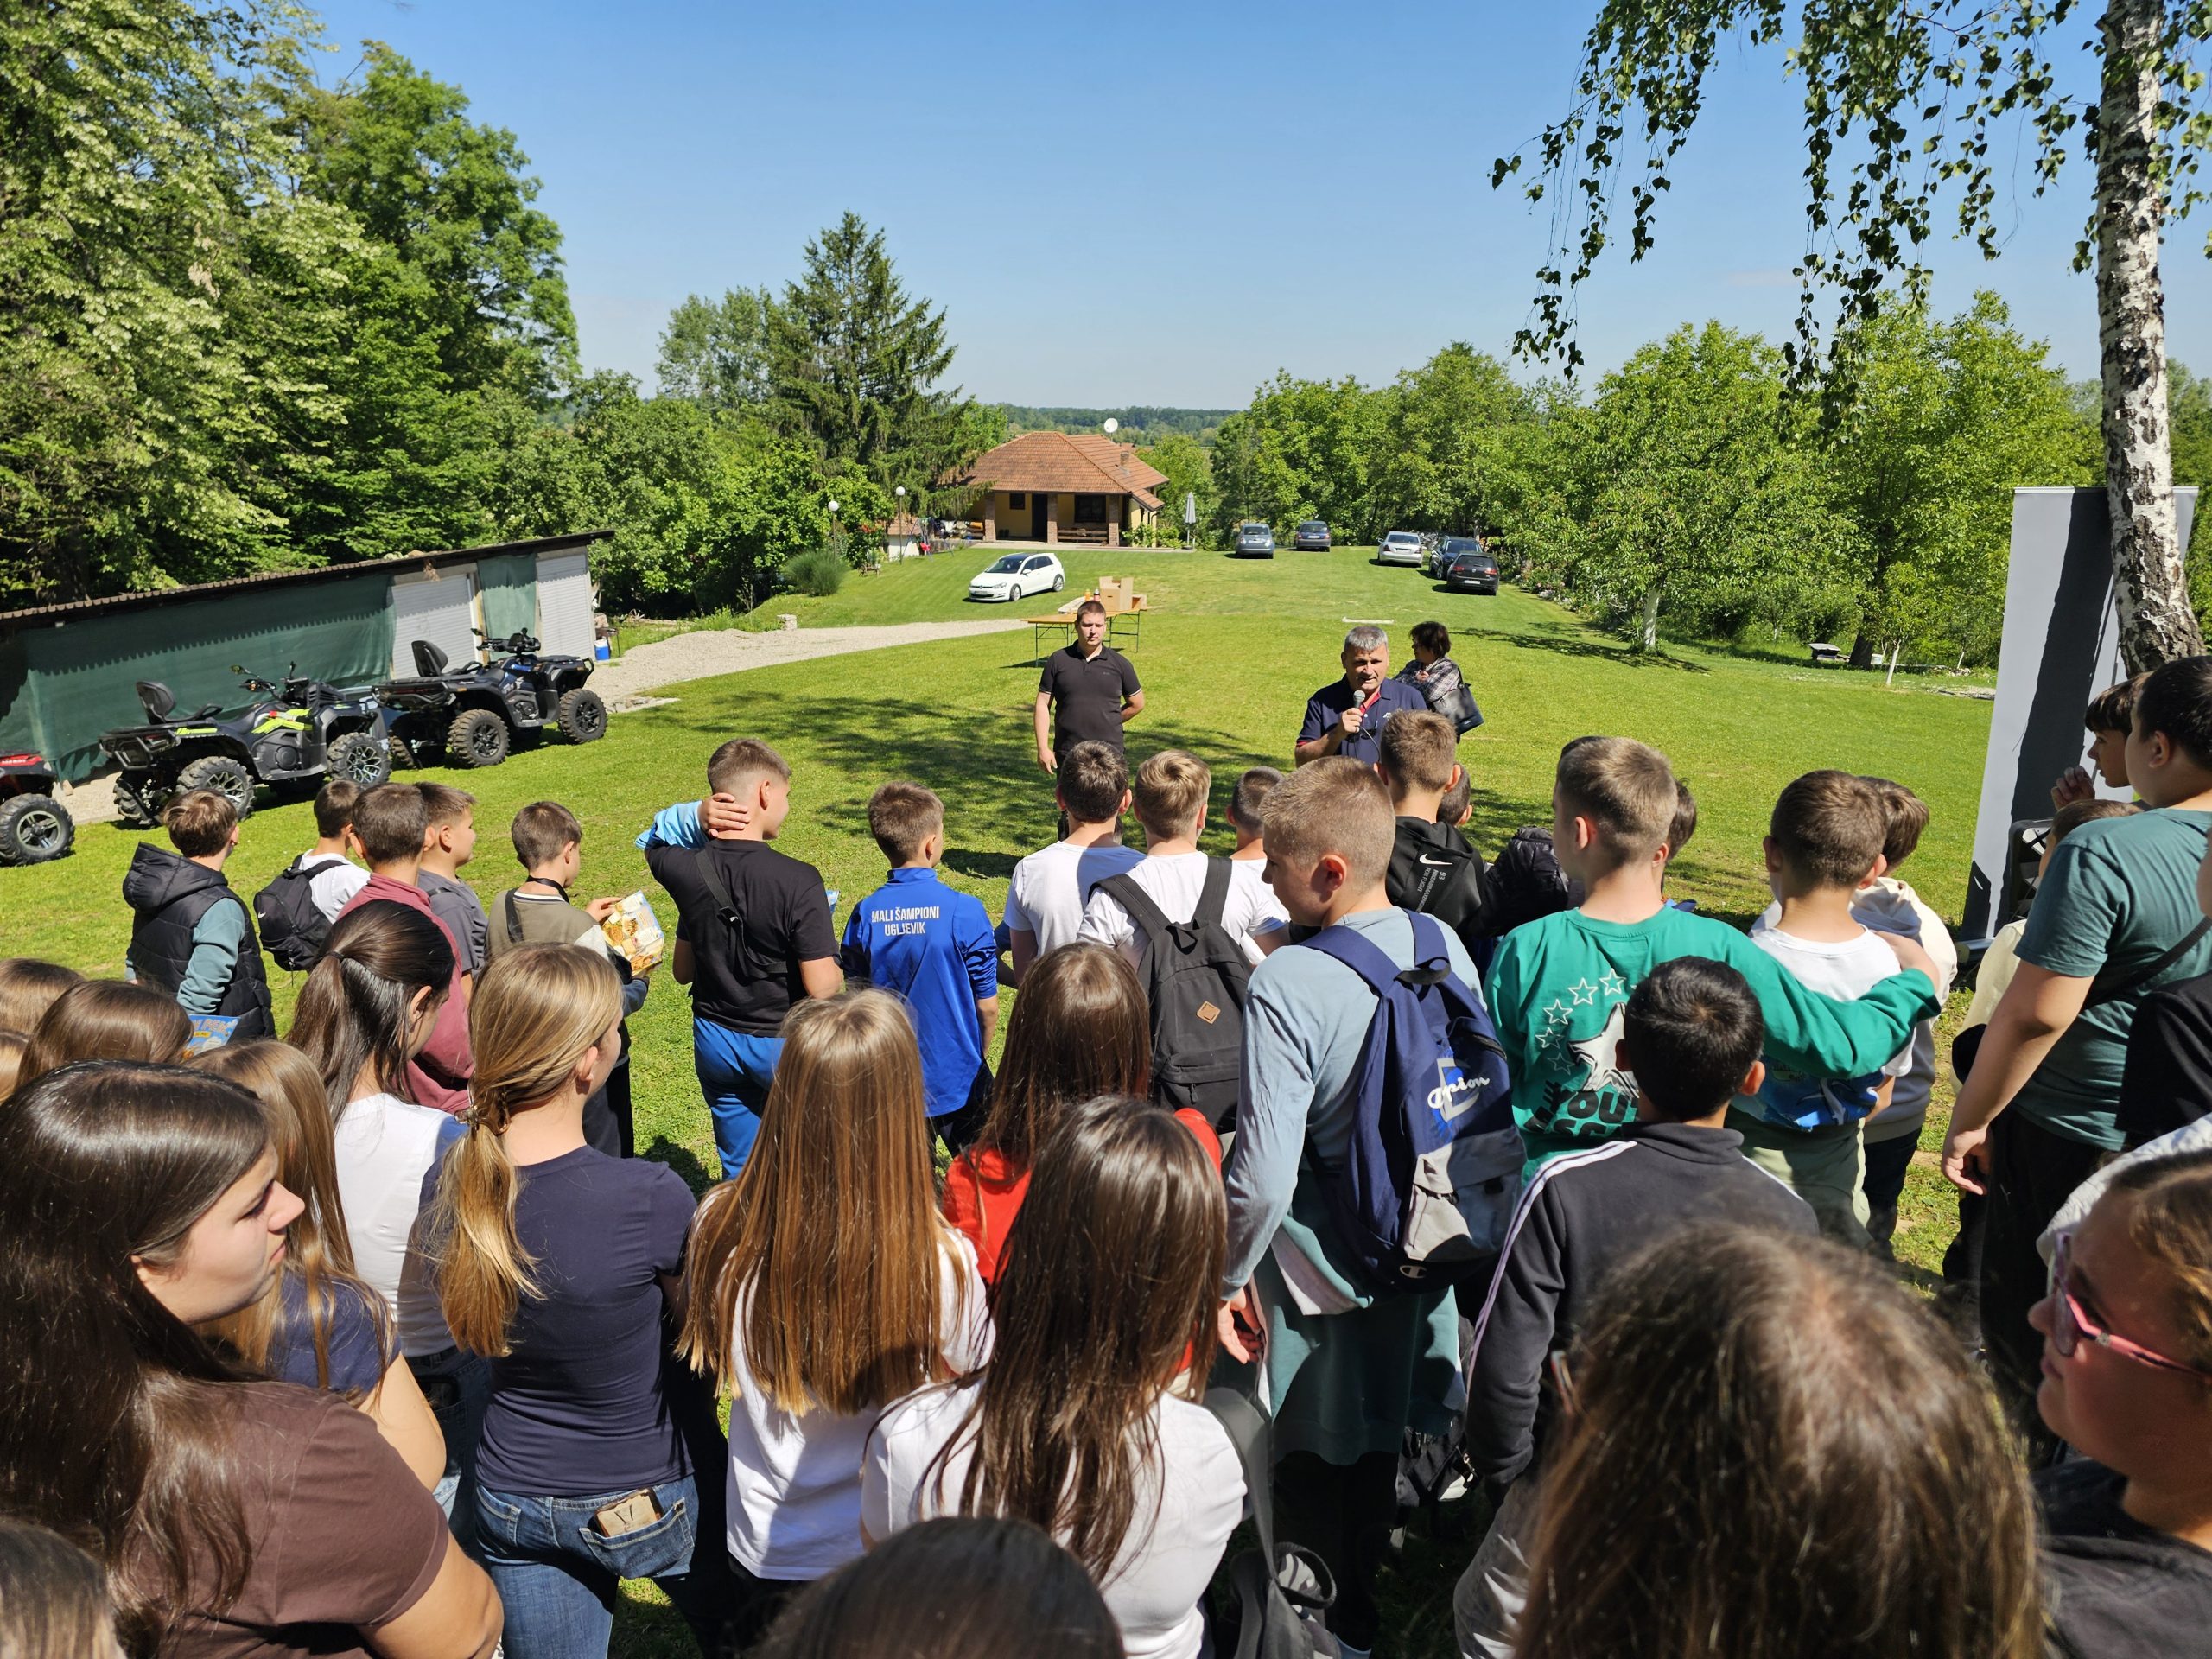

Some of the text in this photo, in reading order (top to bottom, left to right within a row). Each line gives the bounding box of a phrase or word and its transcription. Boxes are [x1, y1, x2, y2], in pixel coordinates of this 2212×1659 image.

[872, 906, 939, 922] MALI ŠAMPIONI
[885, 922, 925, 936] UGLJEVIK
